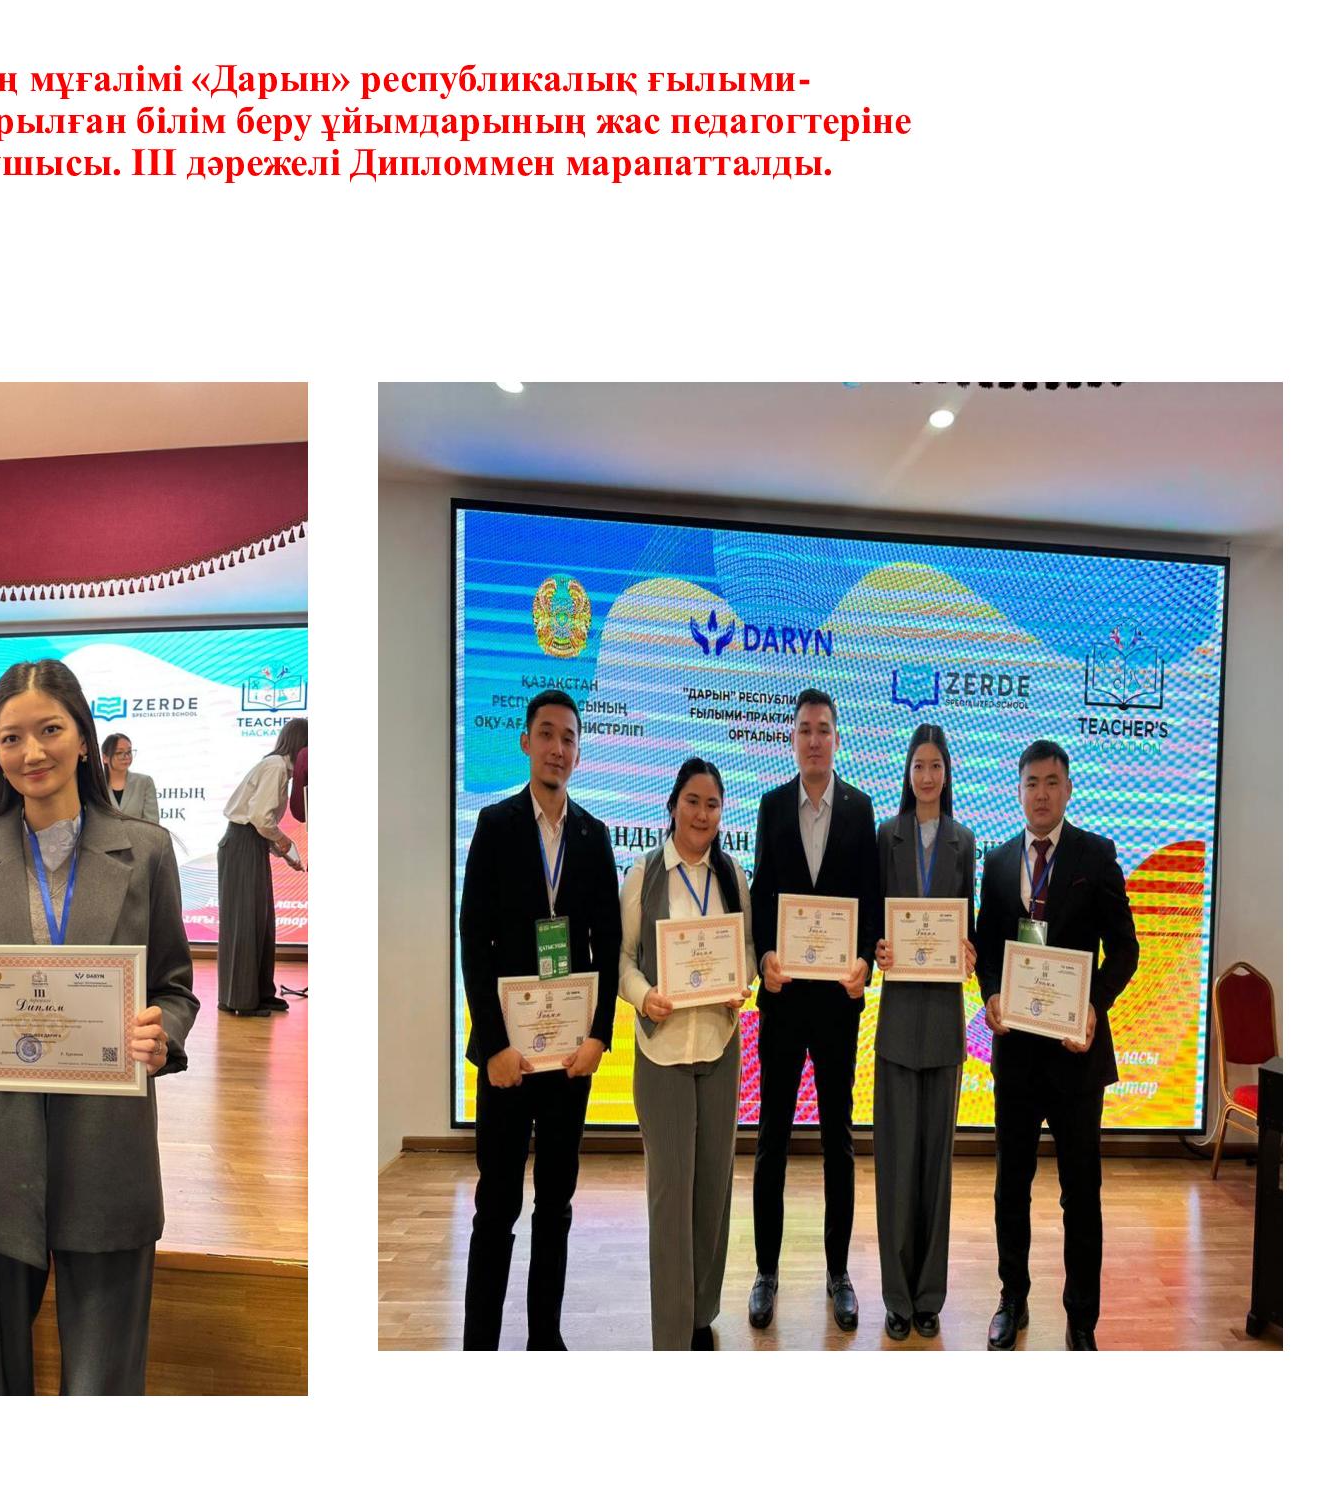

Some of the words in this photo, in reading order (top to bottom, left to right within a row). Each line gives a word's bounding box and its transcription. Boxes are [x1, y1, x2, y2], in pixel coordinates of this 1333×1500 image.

[744, 624, 833, 657] DARYN
[946, 672, 1030, 697] ZERDE
[132, 697, 198, 711] ZERDE
[1078, 717, 1169, 738] TEACHER'S
[34, 989, 45, 998] III
